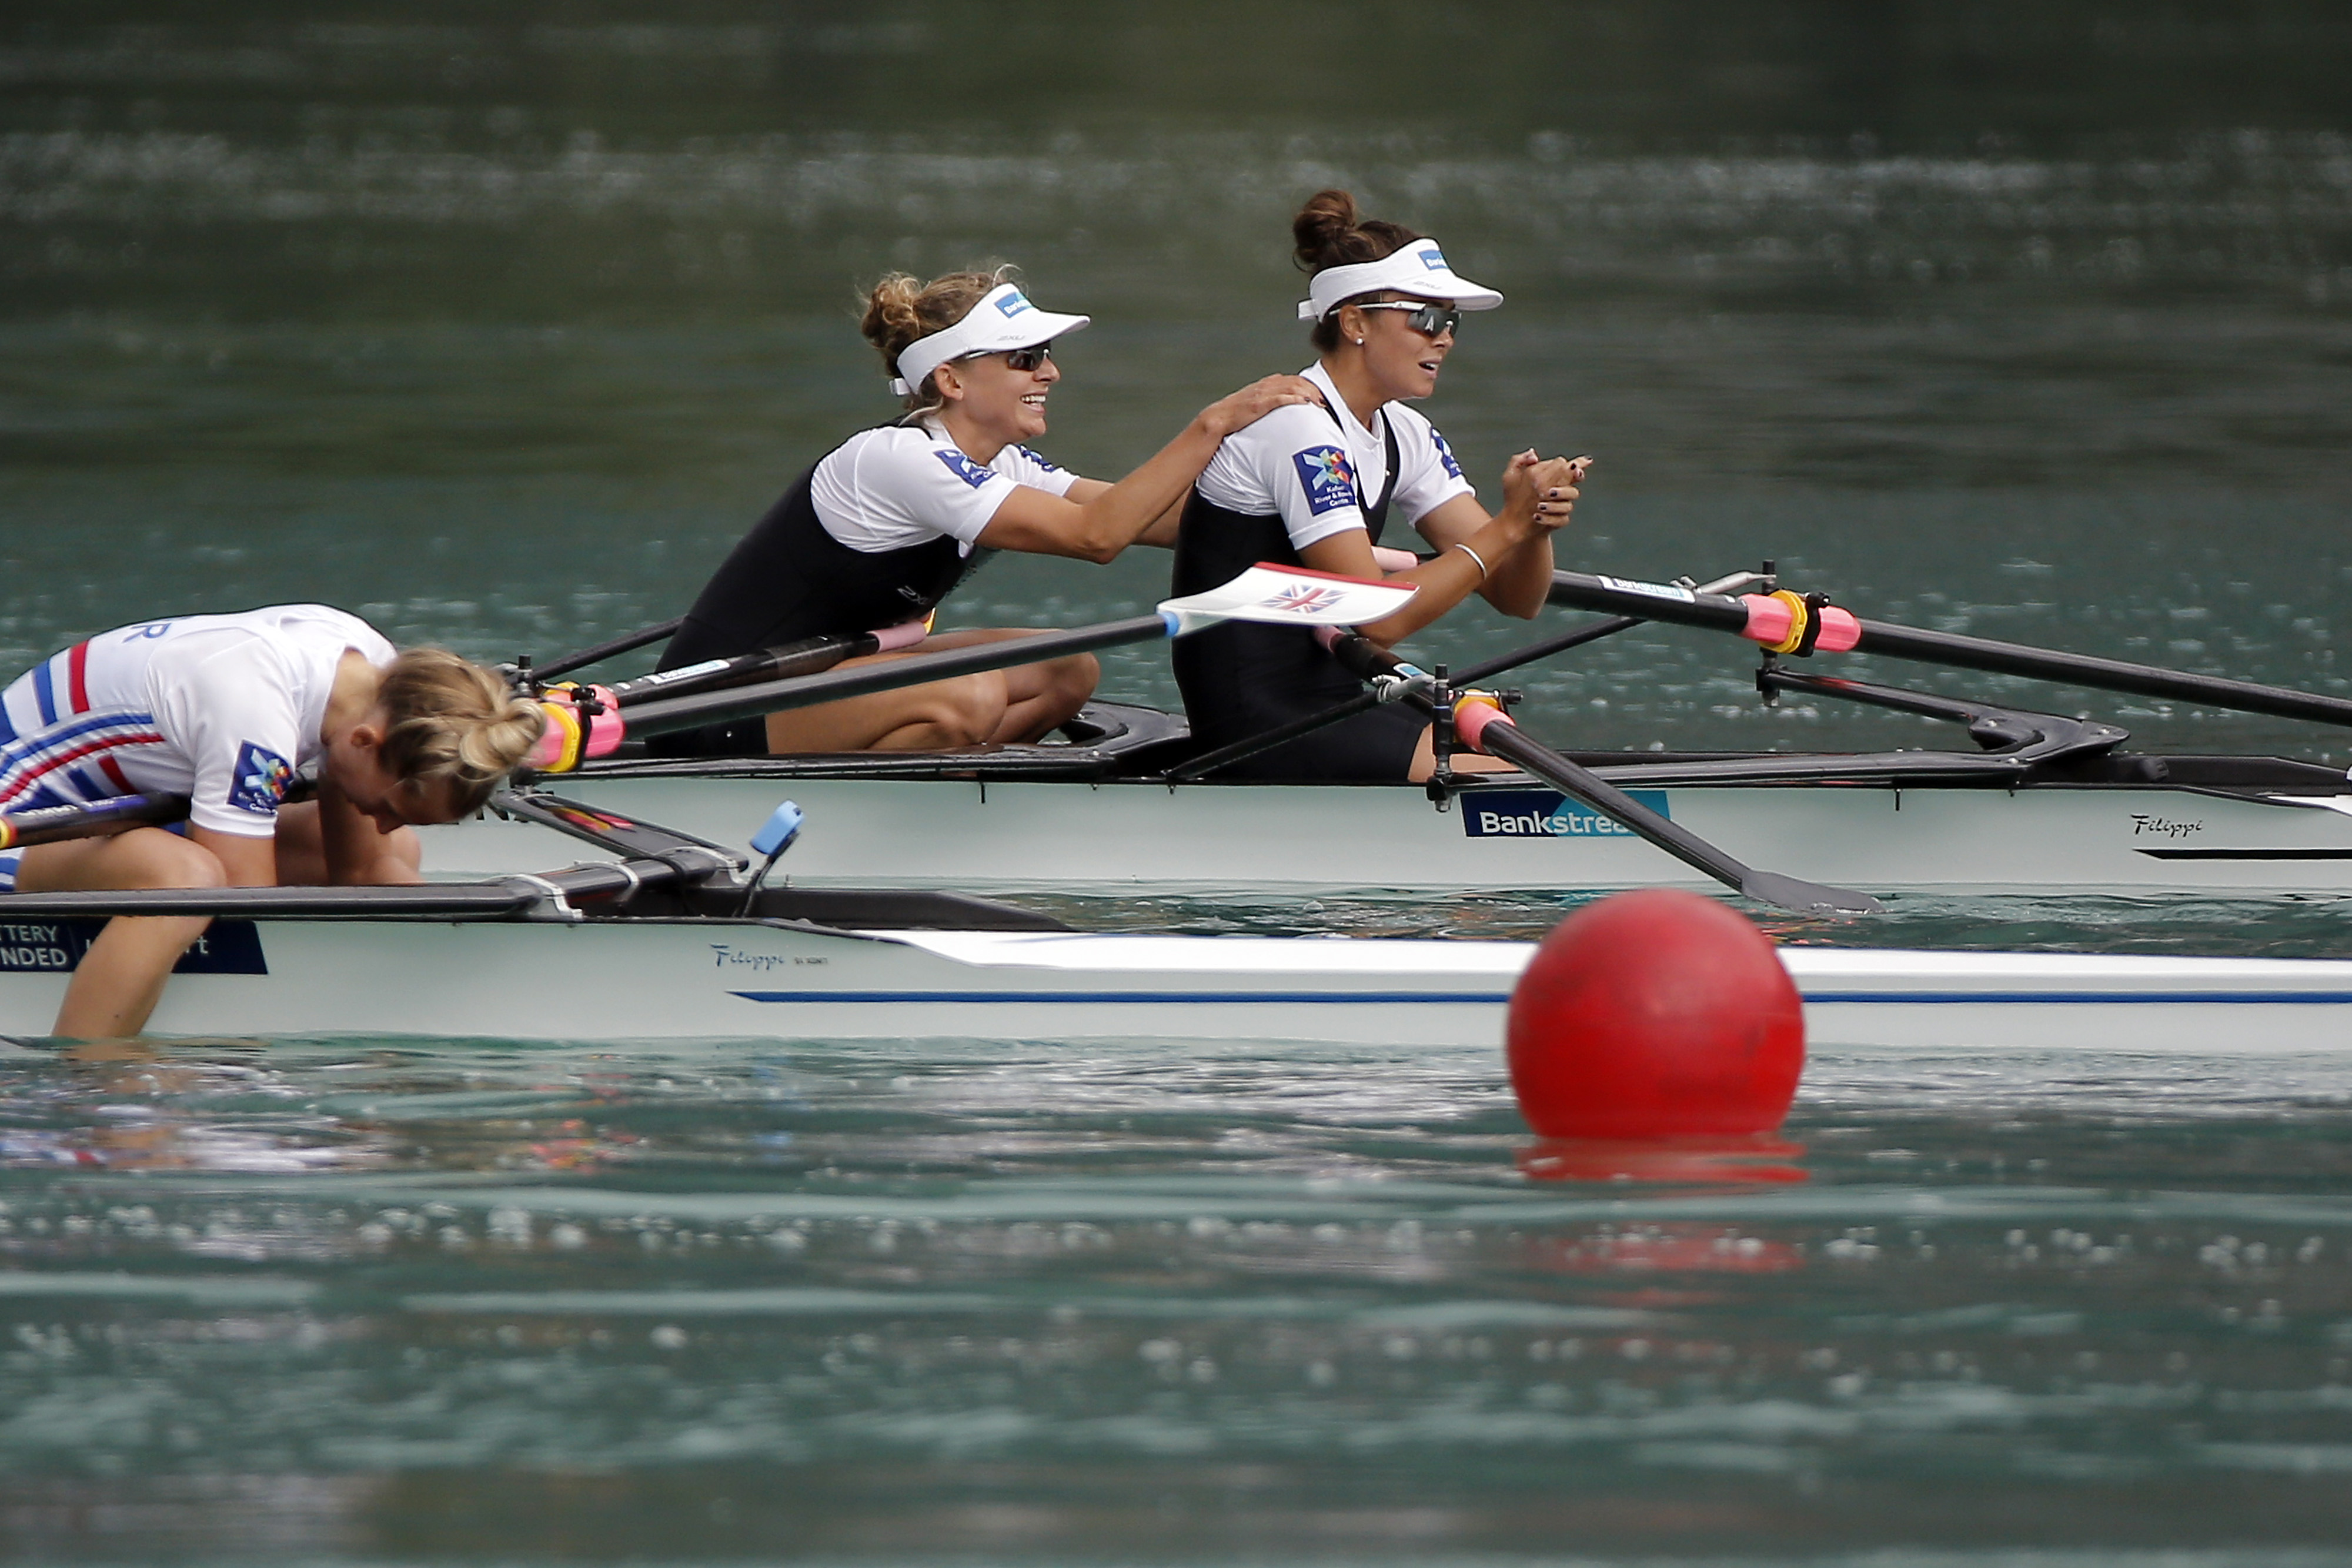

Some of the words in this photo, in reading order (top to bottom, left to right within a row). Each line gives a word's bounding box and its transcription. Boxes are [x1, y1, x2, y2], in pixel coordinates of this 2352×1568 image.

[897, 586, 929, 605] 2X
[1479, 811, 1630, 834] Bankstrea
[2131, 815, 2203, 838] Filippi
